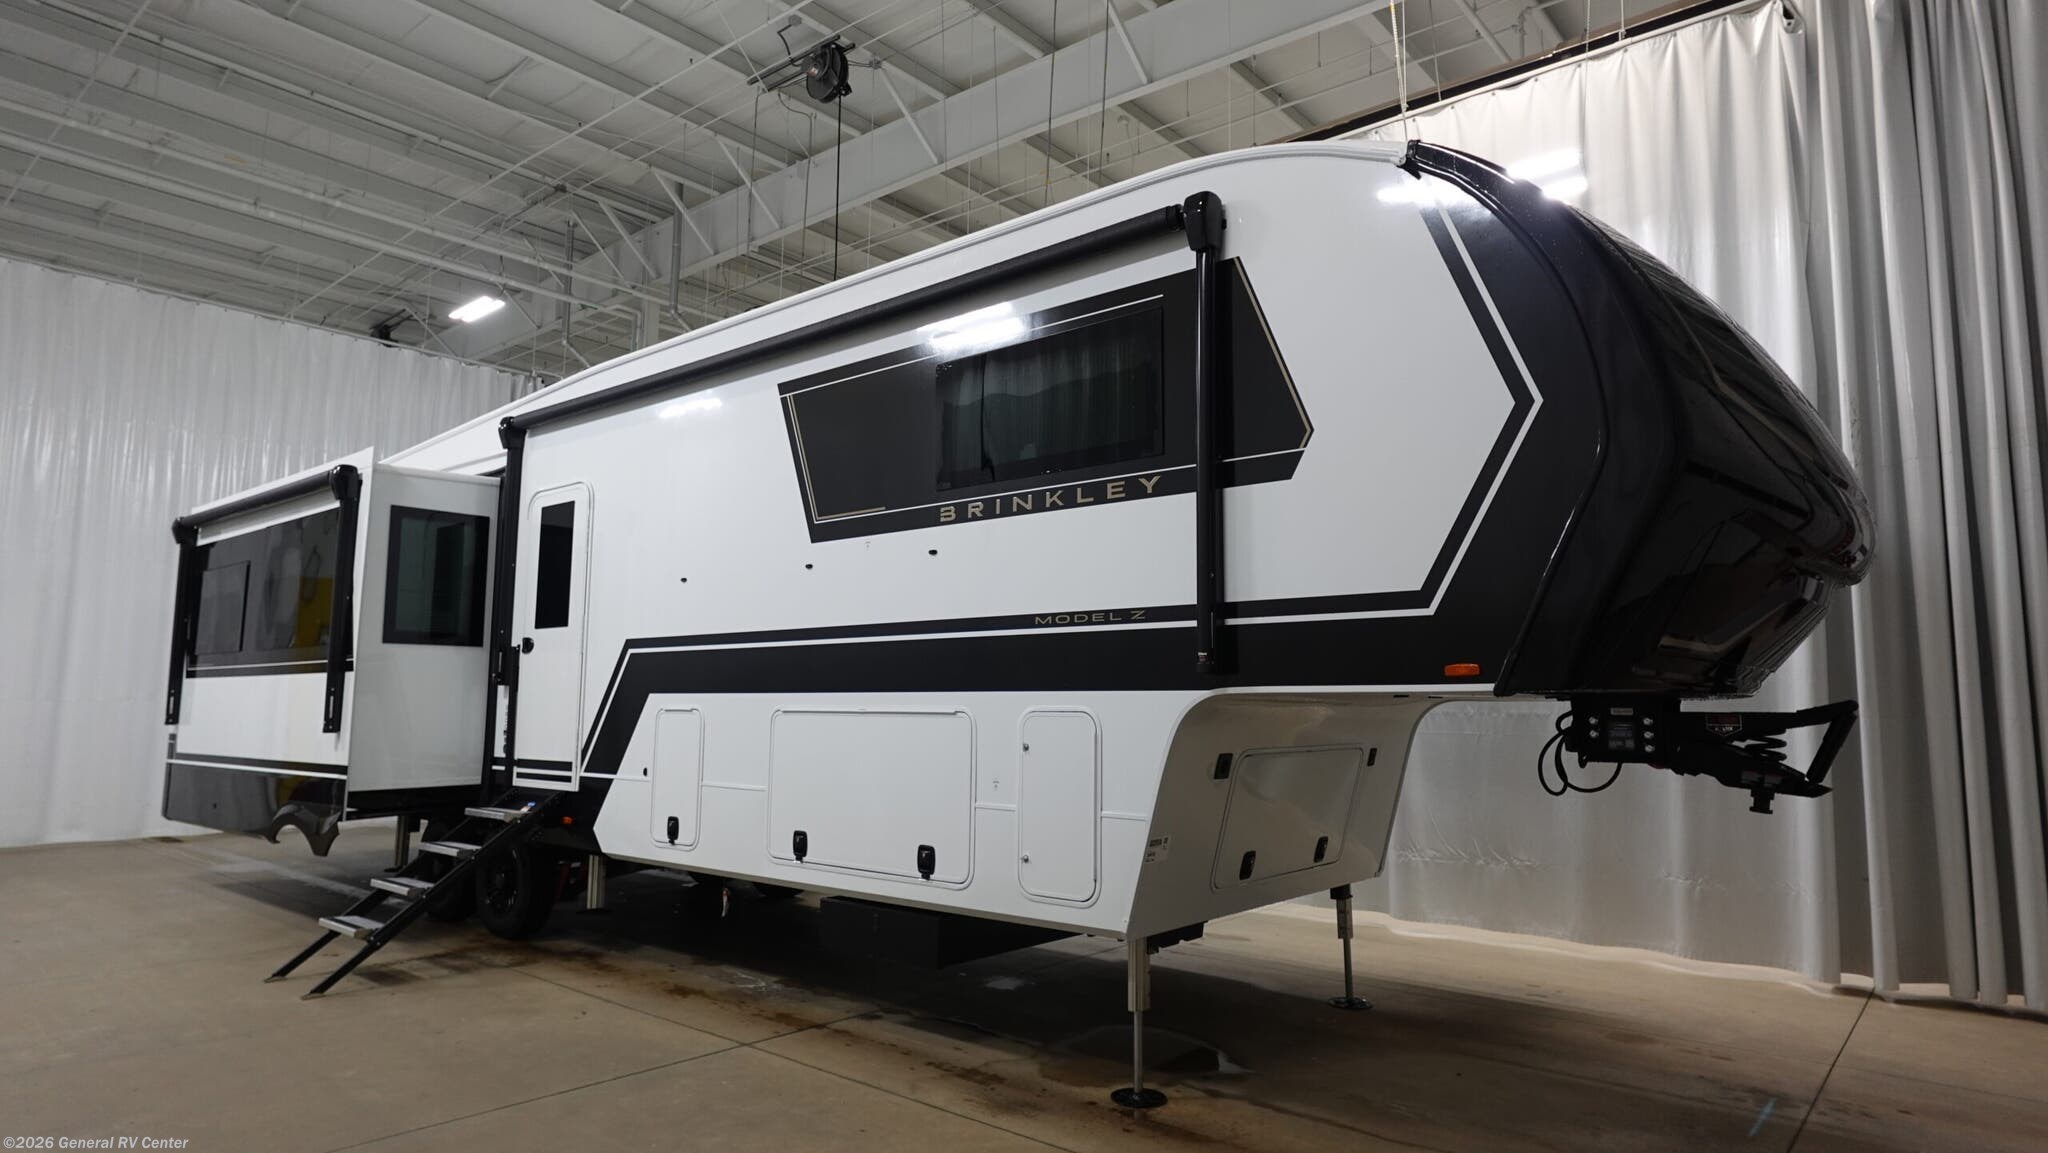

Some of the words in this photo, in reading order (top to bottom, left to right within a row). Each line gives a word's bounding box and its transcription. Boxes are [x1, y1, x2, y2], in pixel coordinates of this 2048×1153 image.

[939, 475, 1161, 522] BRINKLEY
[1035, 611, 1122, 625] MODEL
[1130, 609, 1146, 620] Z
